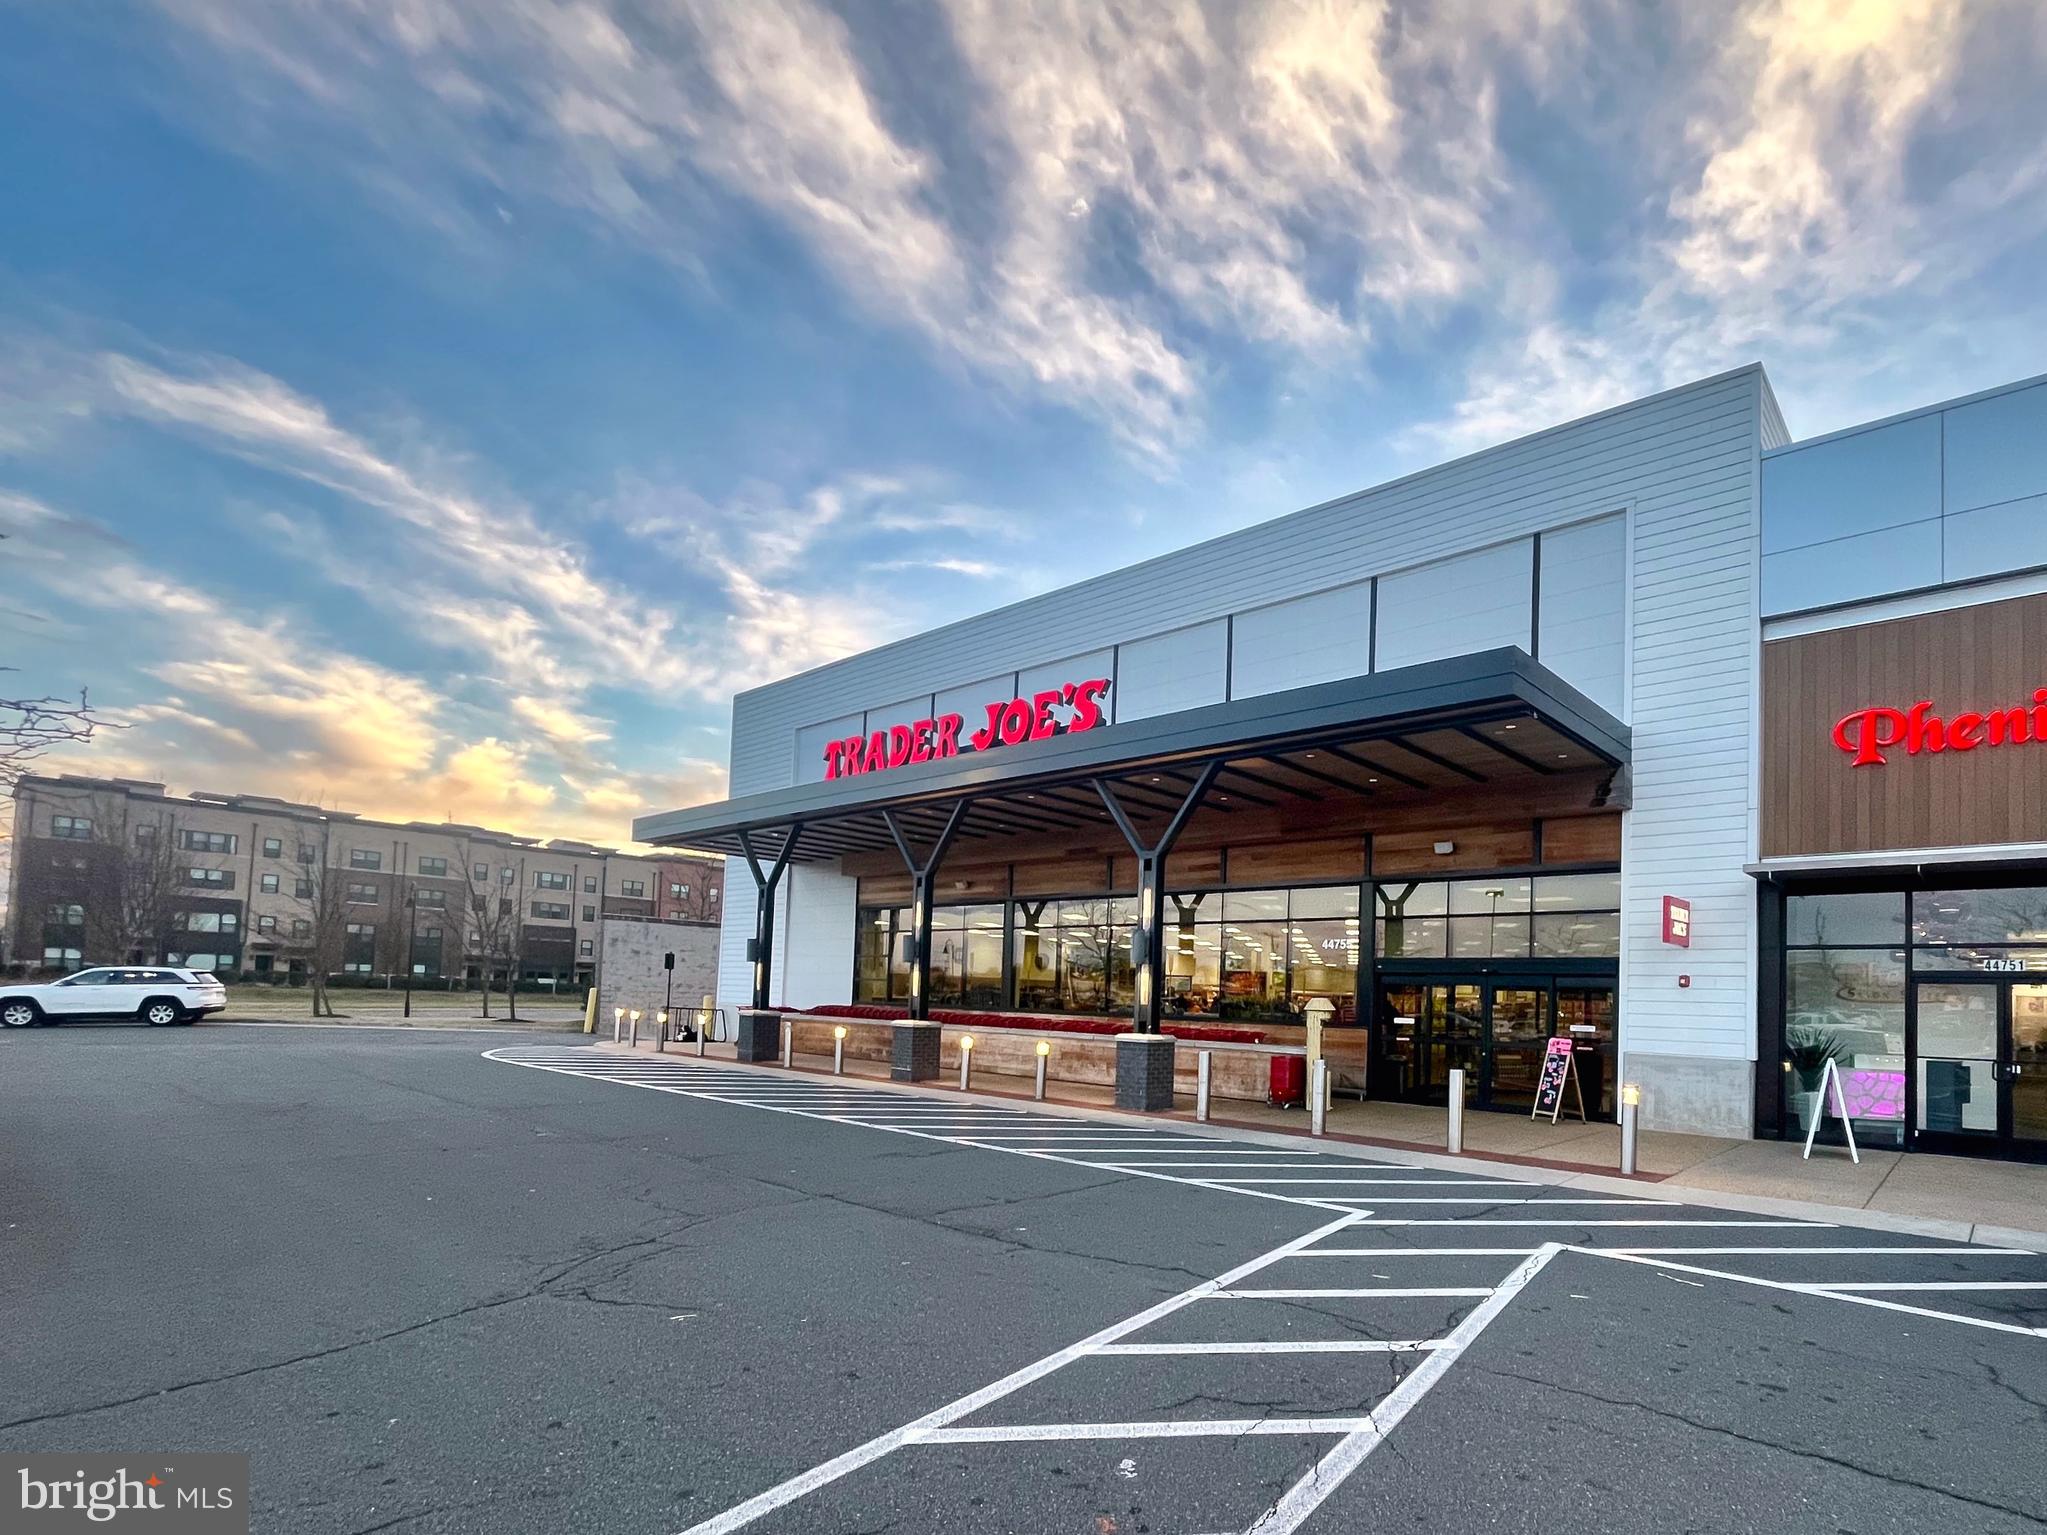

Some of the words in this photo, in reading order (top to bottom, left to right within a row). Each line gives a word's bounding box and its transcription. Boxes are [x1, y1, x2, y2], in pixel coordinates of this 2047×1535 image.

[823, 712, 964, 781] TRADER
[970, 678, 1111, 752] JOE'S
[1984, 959, 2024, 971] 44751
